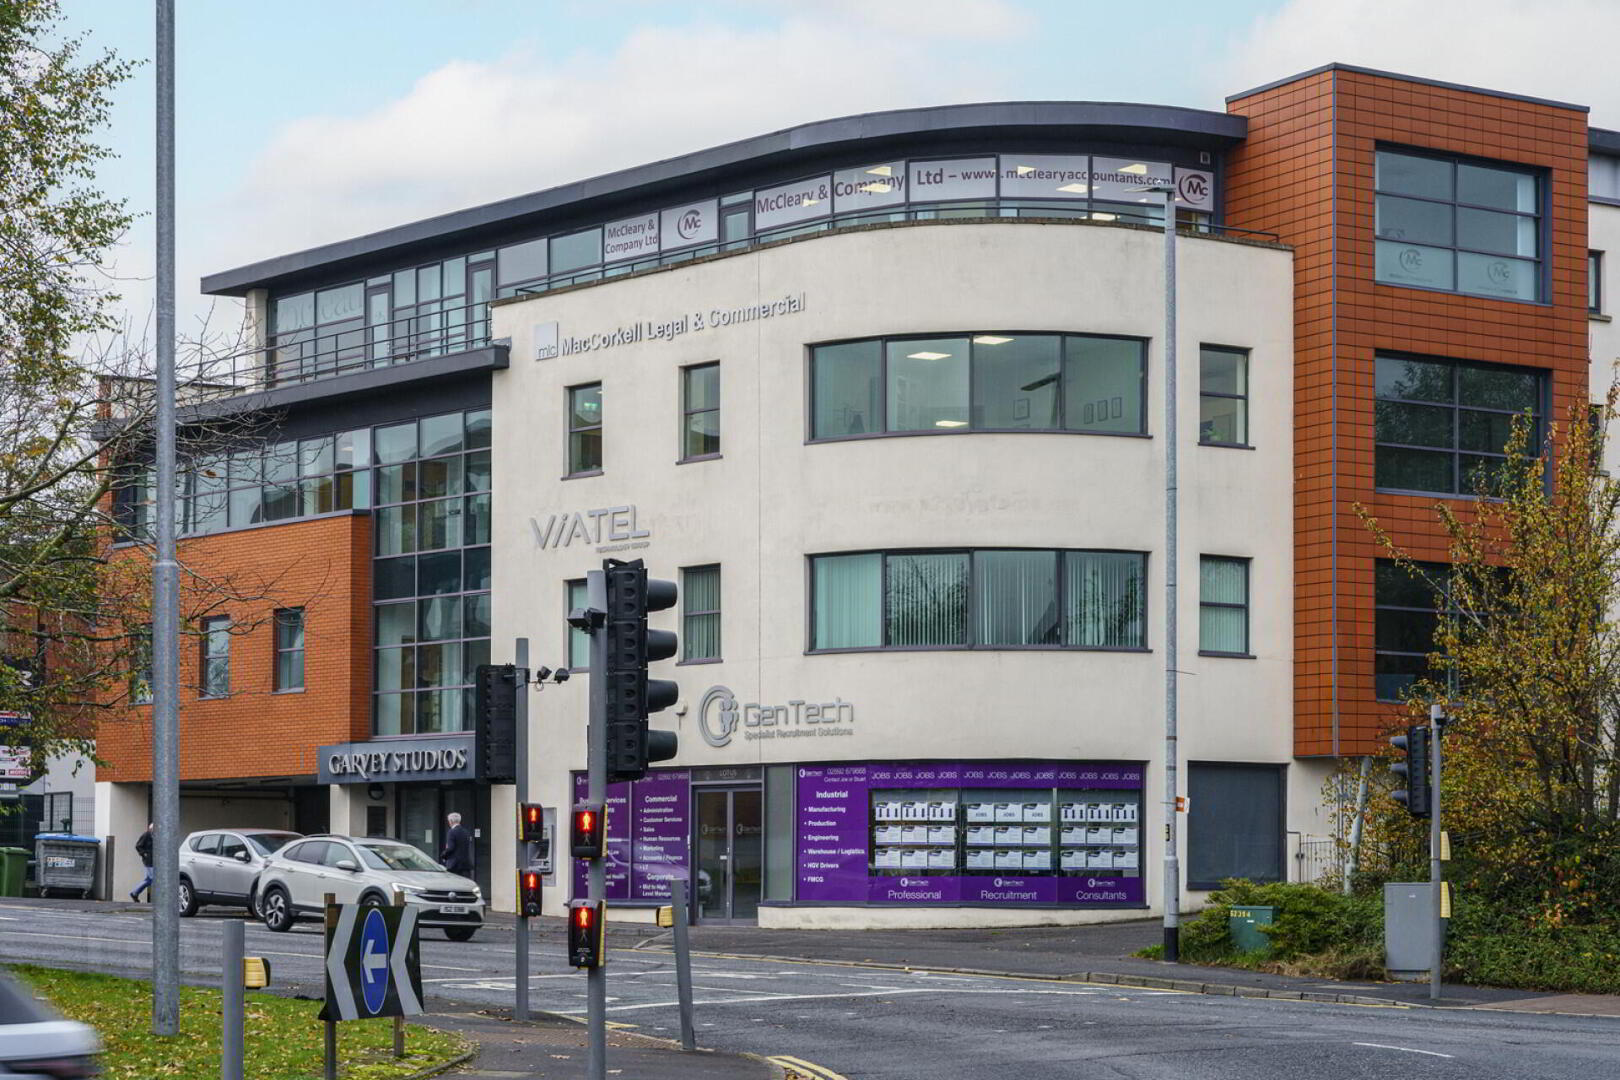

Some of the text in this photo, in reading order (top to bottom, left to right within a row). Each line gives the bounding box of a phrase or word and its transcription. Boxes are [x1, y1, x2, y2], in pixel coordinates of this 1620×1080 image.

[757, 190, 814, 214] McCleary
[818, 184, 828, 200] &
[917, 168, 943, 185] Ltd
[1187, 180, 1208, 196] Mc
[608, 219, 654, 238] McCleary &
[684, 216, 701, 231] Mc
[605, 234, 658, 254] Company Ltd
[562, 292, 806, 356] MacCorkell Legal & Commercial
[744, 697, 854, 728] GenTech
[776, 729, 816, 738] Recruitment
[818, 728, 854, 737] Solutions
[328, 748, 467, 780] GARVEY STUDIOS
[872, 772, 891, 780] JOBS
[915, 771, 935, 779] JOBS
[938, 771, 957, 779] JOBS
[987, 771, 1007, 779] JOBS
[1010, 771, 1031, 779] JOBS
[1034, 771, 1054, 780] JOBS
[1058, 771, 1077, 779] JOBS
[1100, 772, 1119, 780] JOBS
[1122, 772, 1140, 780] JOBS
[816, 790, 848, 798] Industrial
[644, 795, 678, 804] Commercial
[808, 806, 846, 814] Manufacturing
[808, 834, 839, 842] Engineering
[888, 890, 942, 899] Professional
[980, 890, 1038, 899] Recruitment
[1076, 890, 1127, 900] Consultants
